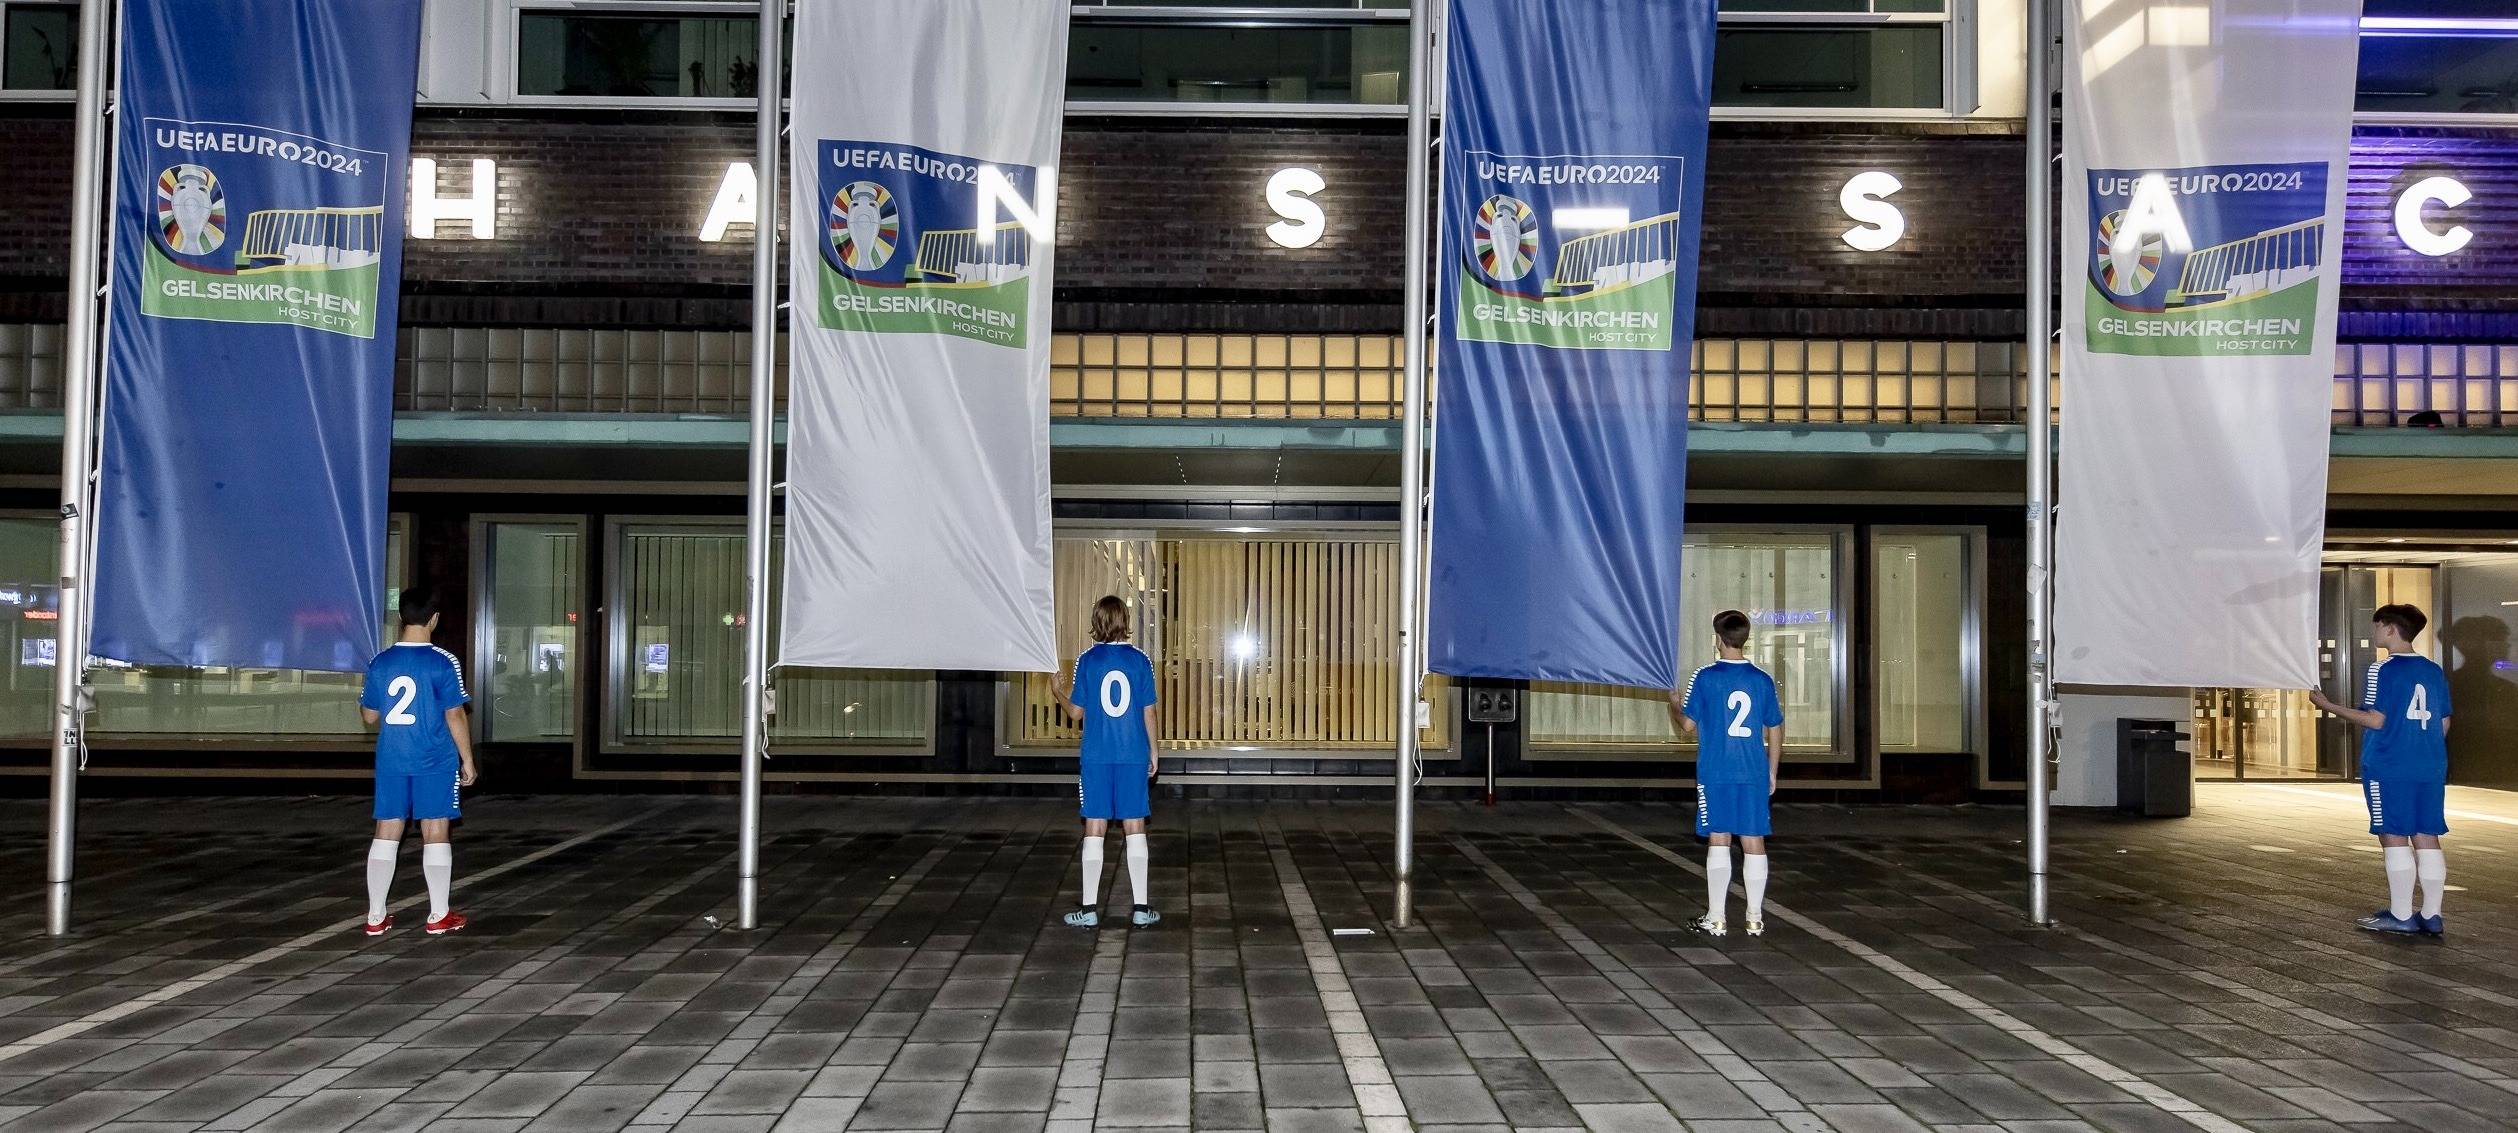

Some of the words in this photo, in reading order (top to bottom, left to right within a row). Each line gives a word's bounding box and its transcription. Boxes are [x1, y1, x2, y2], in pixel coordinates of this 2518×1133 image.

[162, 279, 361, 316] GELSENKIRCHEN
[833, 294, 1016, 329] GELSENKIRCHEN
[278, 306, 322, 323] HOST
[322, 313, 358, 330] CITY
[1473, 303, 1659, 329] GELSENKIRCHEN
[2097, 317, 2301, 337] GELSENKIRCHEN
[952, 321, 986, 337] HOST
[986, 327, 1014, 343] CITY
[1589, 332, 1624, 343] HOST
[1625, 332, 1657, 343] CITY
[2216, 339, 2260, 351] HOST
[2260, 339, 2298, 351] CITY
[385, 675, 417, 725] 2
[1100, 670, 1131, 718] 0
[2406, 683, 2432, 730] 4
[1727, 690, 1752, 738] 2
